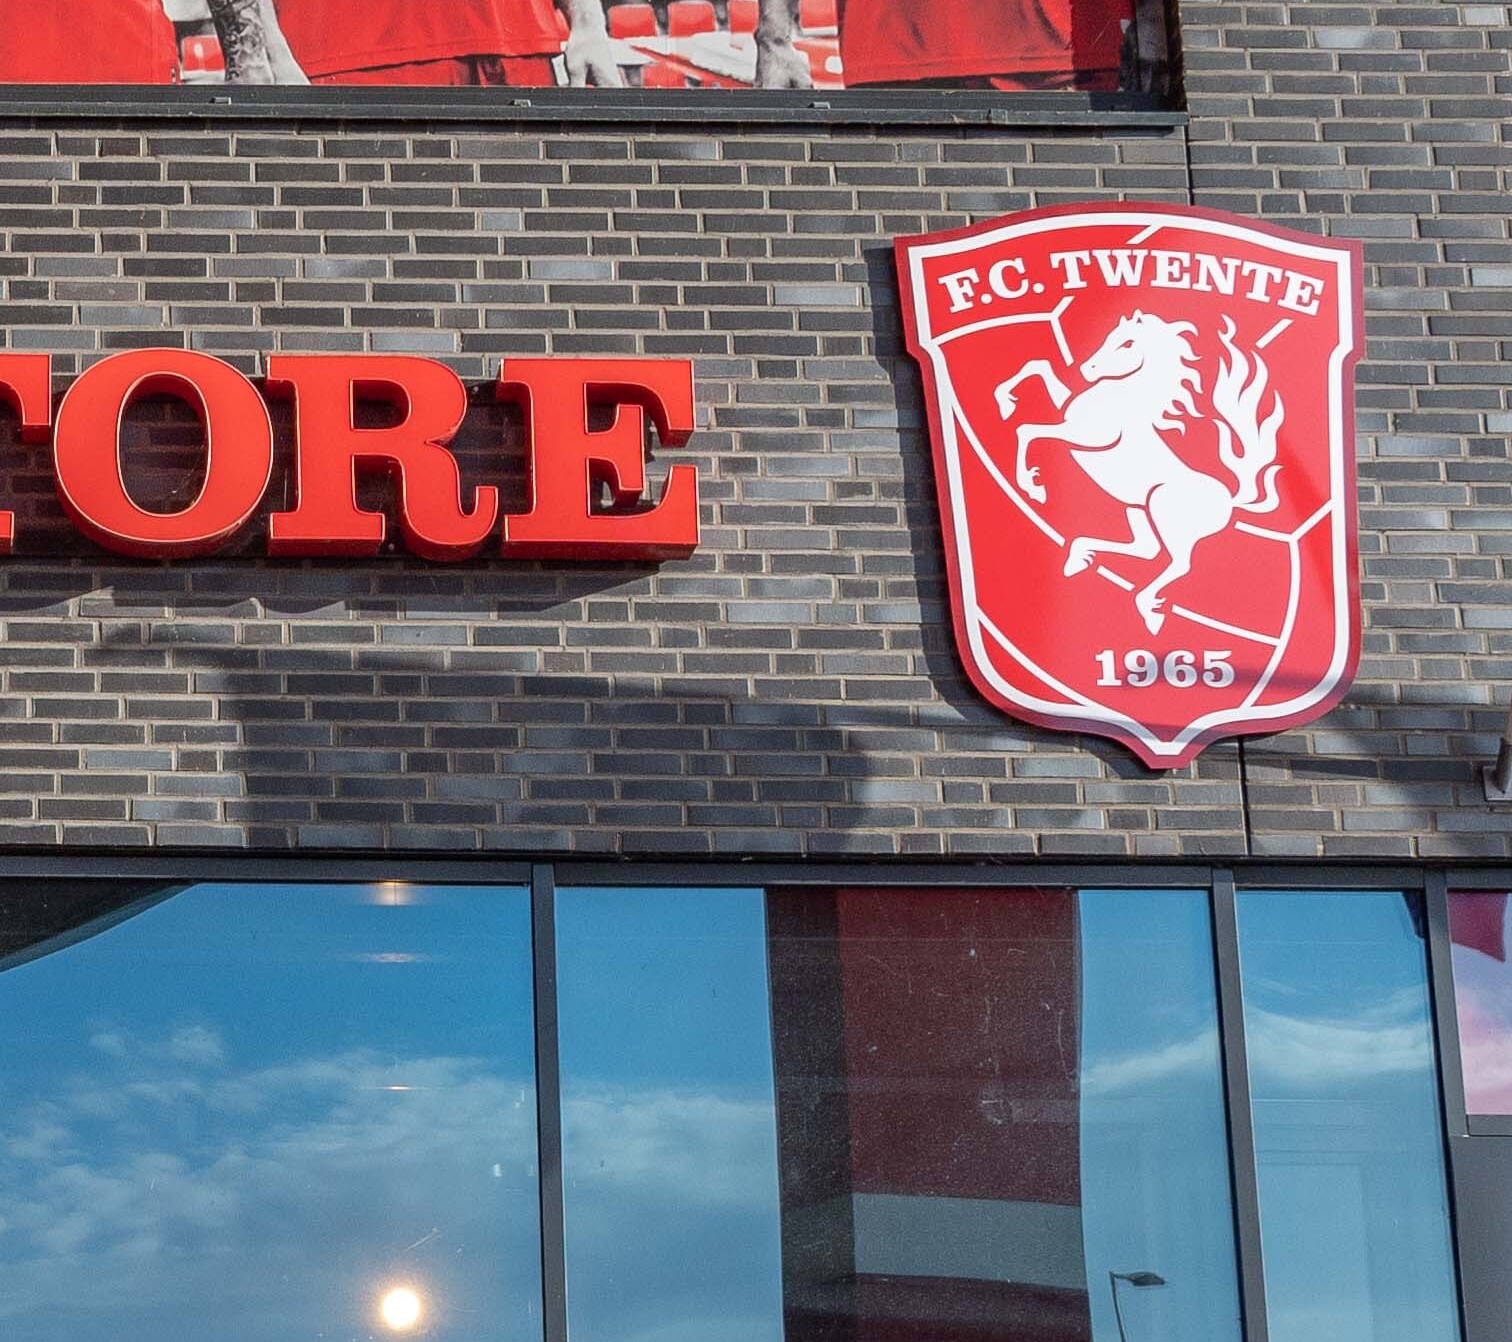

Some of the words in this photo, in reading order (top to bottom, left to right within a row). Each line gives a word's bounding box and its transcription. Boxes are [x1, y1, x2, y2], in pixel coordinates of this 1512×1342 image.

[938, 257, 1045, 314] F.C.
[1050, 247, 1326, 317] TWENTE
[1094, 648, 1236, 688] 1965
